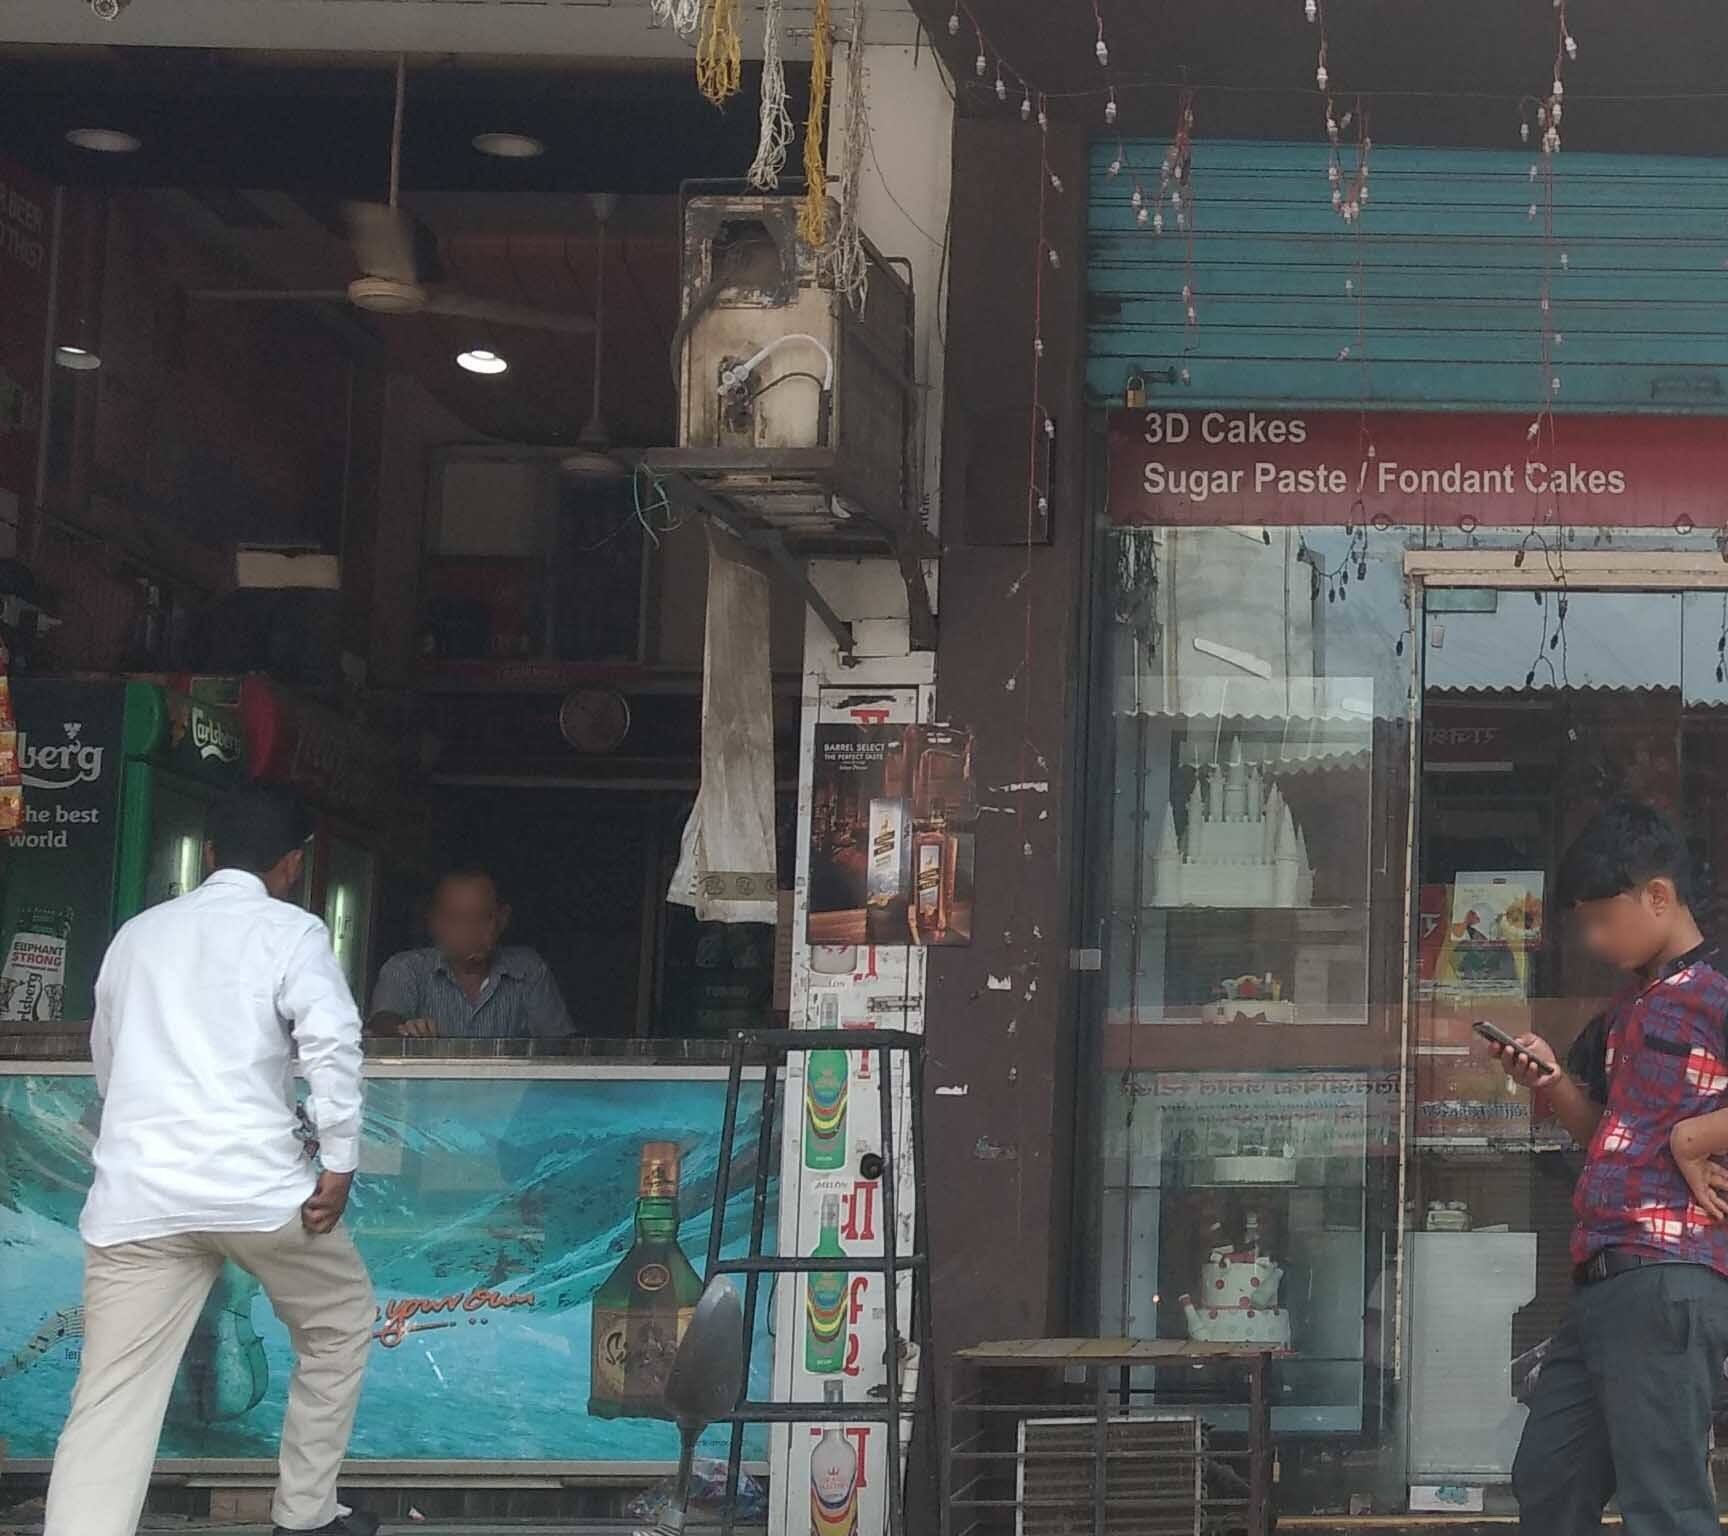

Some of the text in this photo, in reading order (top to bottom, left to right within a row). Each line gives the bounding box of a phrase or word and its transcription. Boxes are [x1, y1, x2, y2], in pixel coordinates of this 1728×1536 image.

[1143, 412, 1307, 444] 3D Cakes
[1143, 462, 1244, 502] Sugar
[1254, 462, 1348, 494] Paste
[1377, 462, 1514, 495] Fondant
[1525, 462, 1626, 495] Cakes
[823, 743, 885, 752] BARREL SELECT
[55, 805, 100, 824] best
[8, 830, 68, 849] world
[11, 951, 62, 967] STRONG
